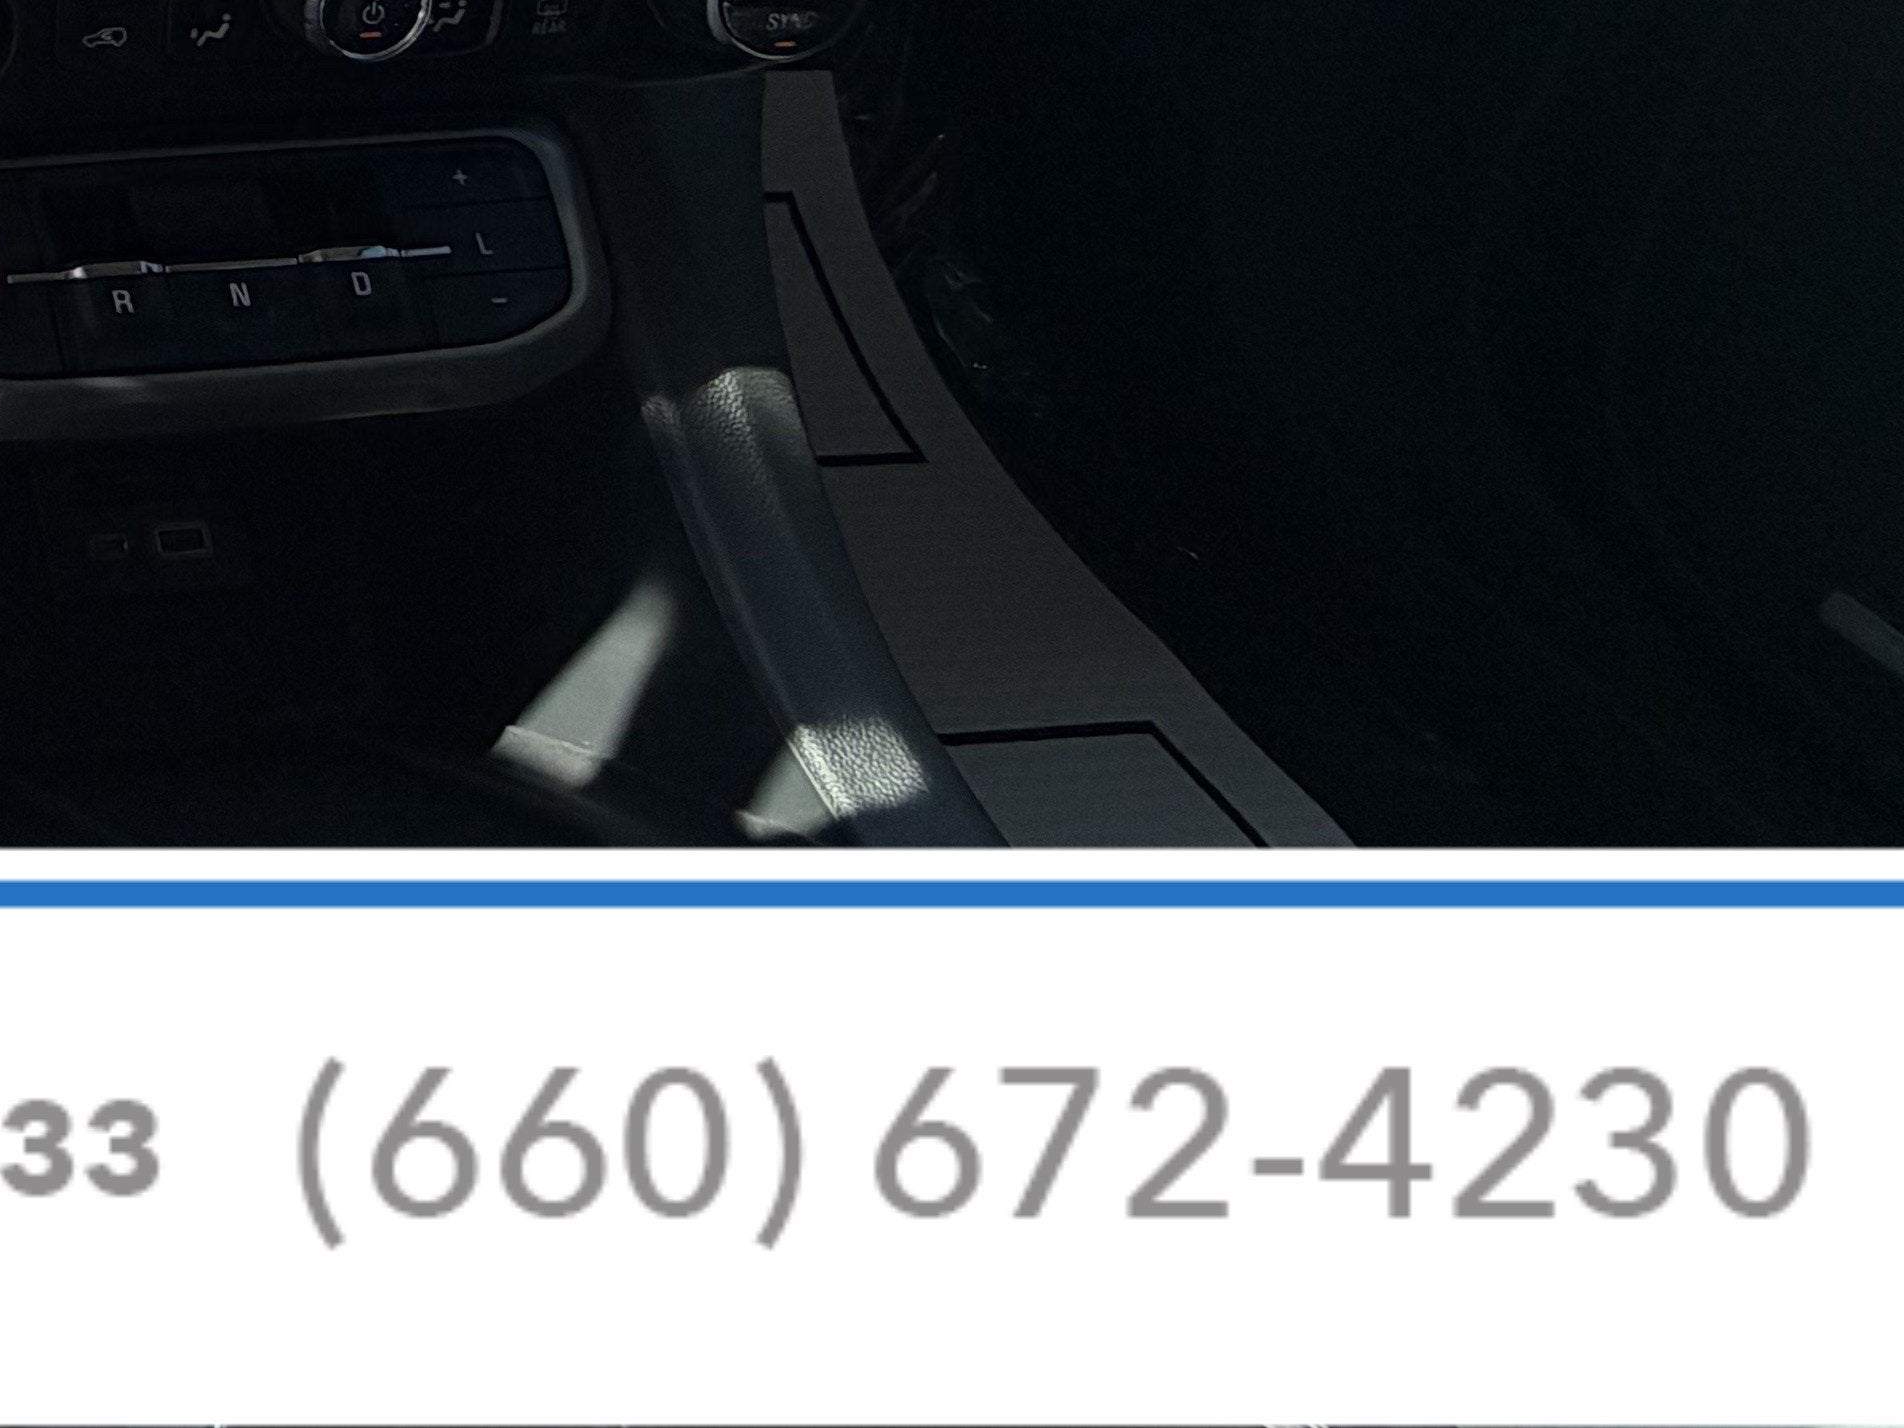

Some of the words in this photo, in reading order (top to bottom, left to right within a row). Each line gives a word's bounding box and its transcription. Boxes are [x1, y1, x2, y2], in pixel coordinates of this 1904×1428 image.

[474, 232, 494, 256] L
[229, 281, 252, 309] N
[350, 271, 373, 297] D
[111, 289, 135, 315] R
